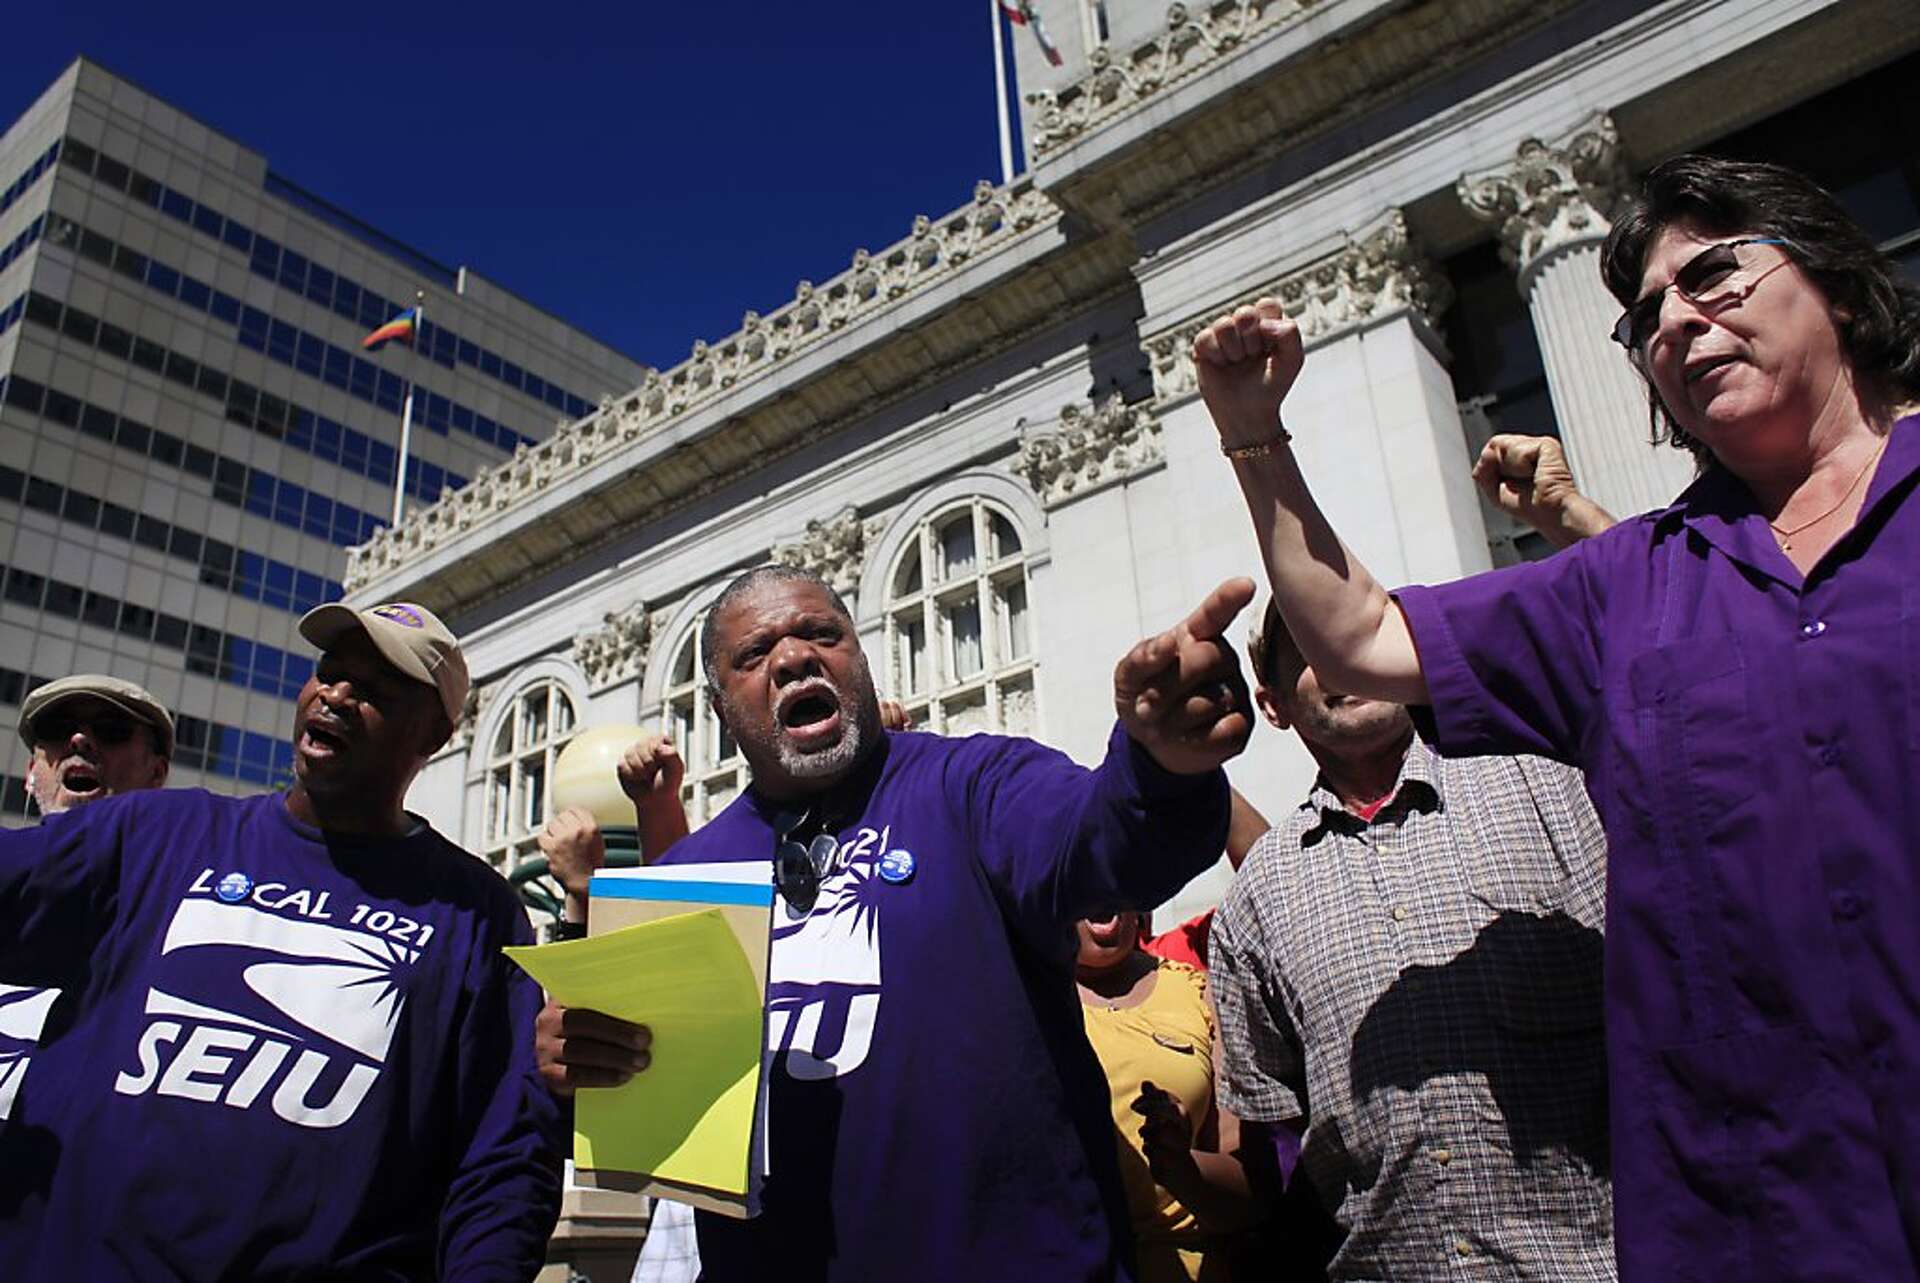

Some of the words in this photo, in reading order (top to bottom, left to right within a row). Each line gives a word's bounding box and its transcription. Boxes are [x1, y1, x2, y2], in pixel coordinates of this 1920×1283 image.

[188, 868, 332, 920] LCAL
[350, 903, 435, 948] 1021
[115, 1021, 381, 1129] SEIU
